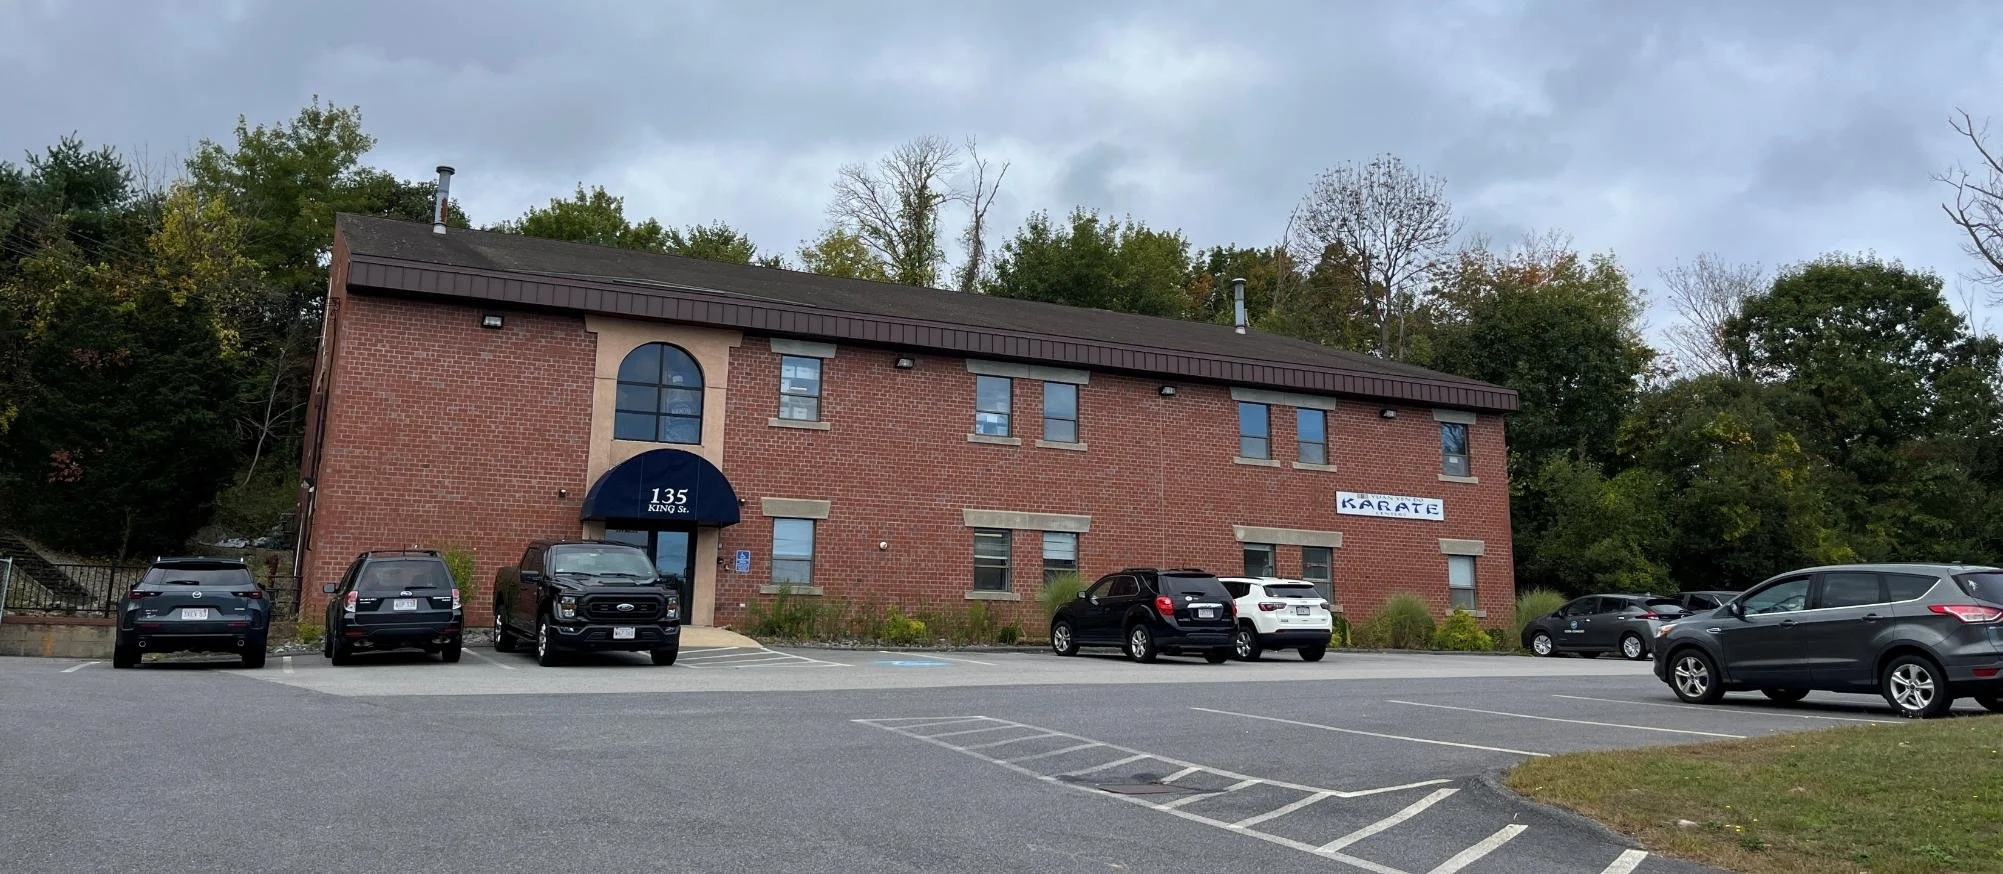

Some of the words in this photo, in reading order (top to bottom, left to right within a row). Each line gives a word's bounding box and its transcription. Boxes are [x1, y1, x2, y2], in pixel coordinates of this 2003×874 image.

[650, 488, 688, 504] 135
[647, 504, 676, 514] KING
[677, 505, 690, 513] St.
[1342, 498, 1438, 514] KARATE
